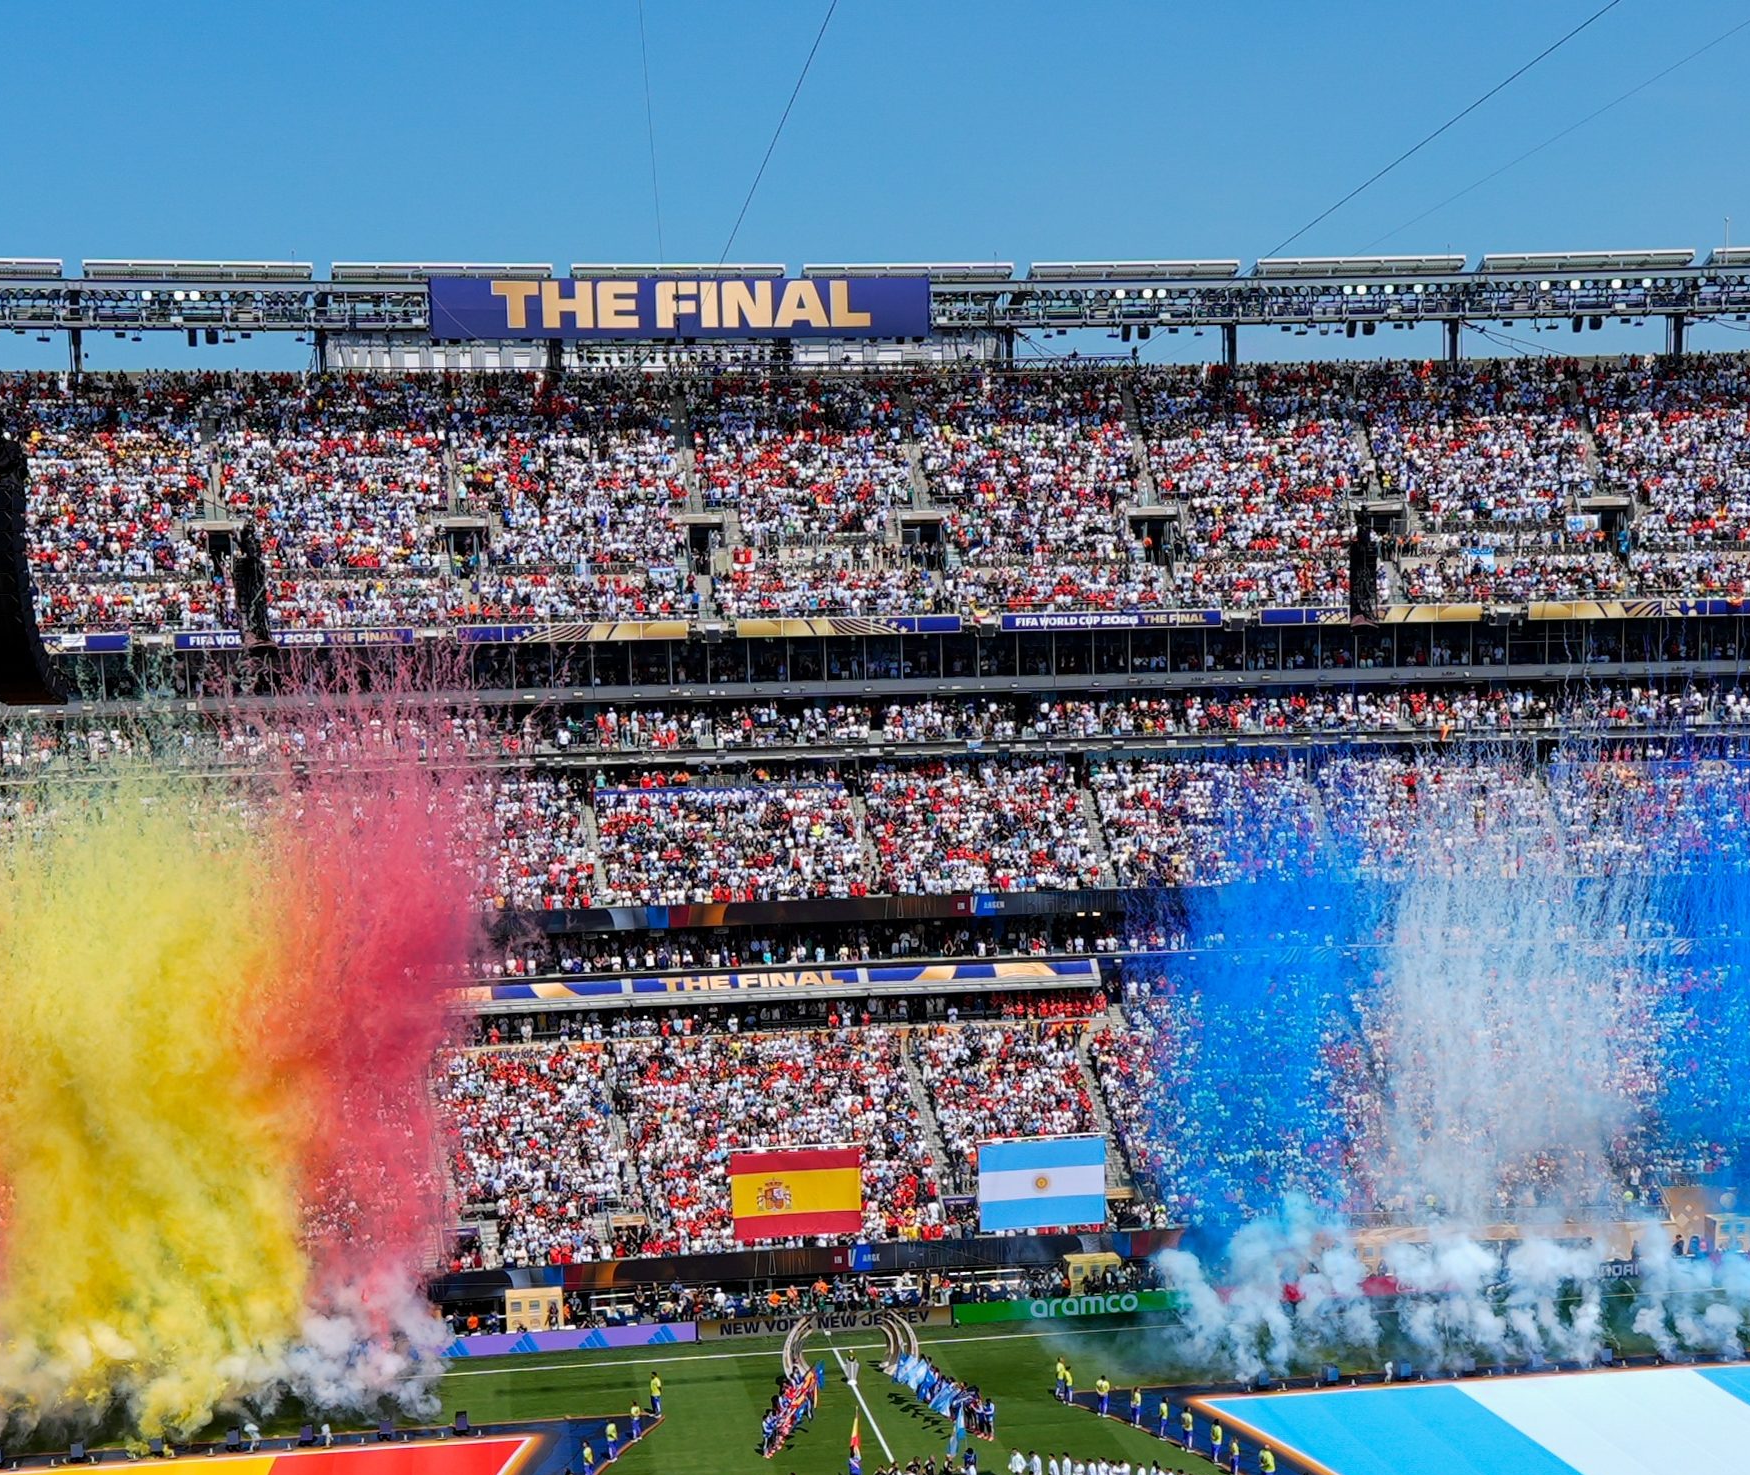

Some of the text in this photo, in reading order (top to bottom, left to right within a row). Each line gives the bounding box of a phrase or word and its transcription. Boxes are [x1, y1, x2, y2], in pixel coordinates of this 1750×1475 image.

[490, 280, 871, 329] THE FINAL
[1015, 613, 1207, 627] FIFA WORLD CUP 2026 THE FINAL
[188, 636, 215, 647] FIFA
[283, 633, 325, 644] 2026
[657, 969, 845, 993] THE FINAL
[1029, 1293, 1139, 1318] aramco
[719, 1319, 760, 1337] NEW
[817, 1312, 858, 1329] NEW
